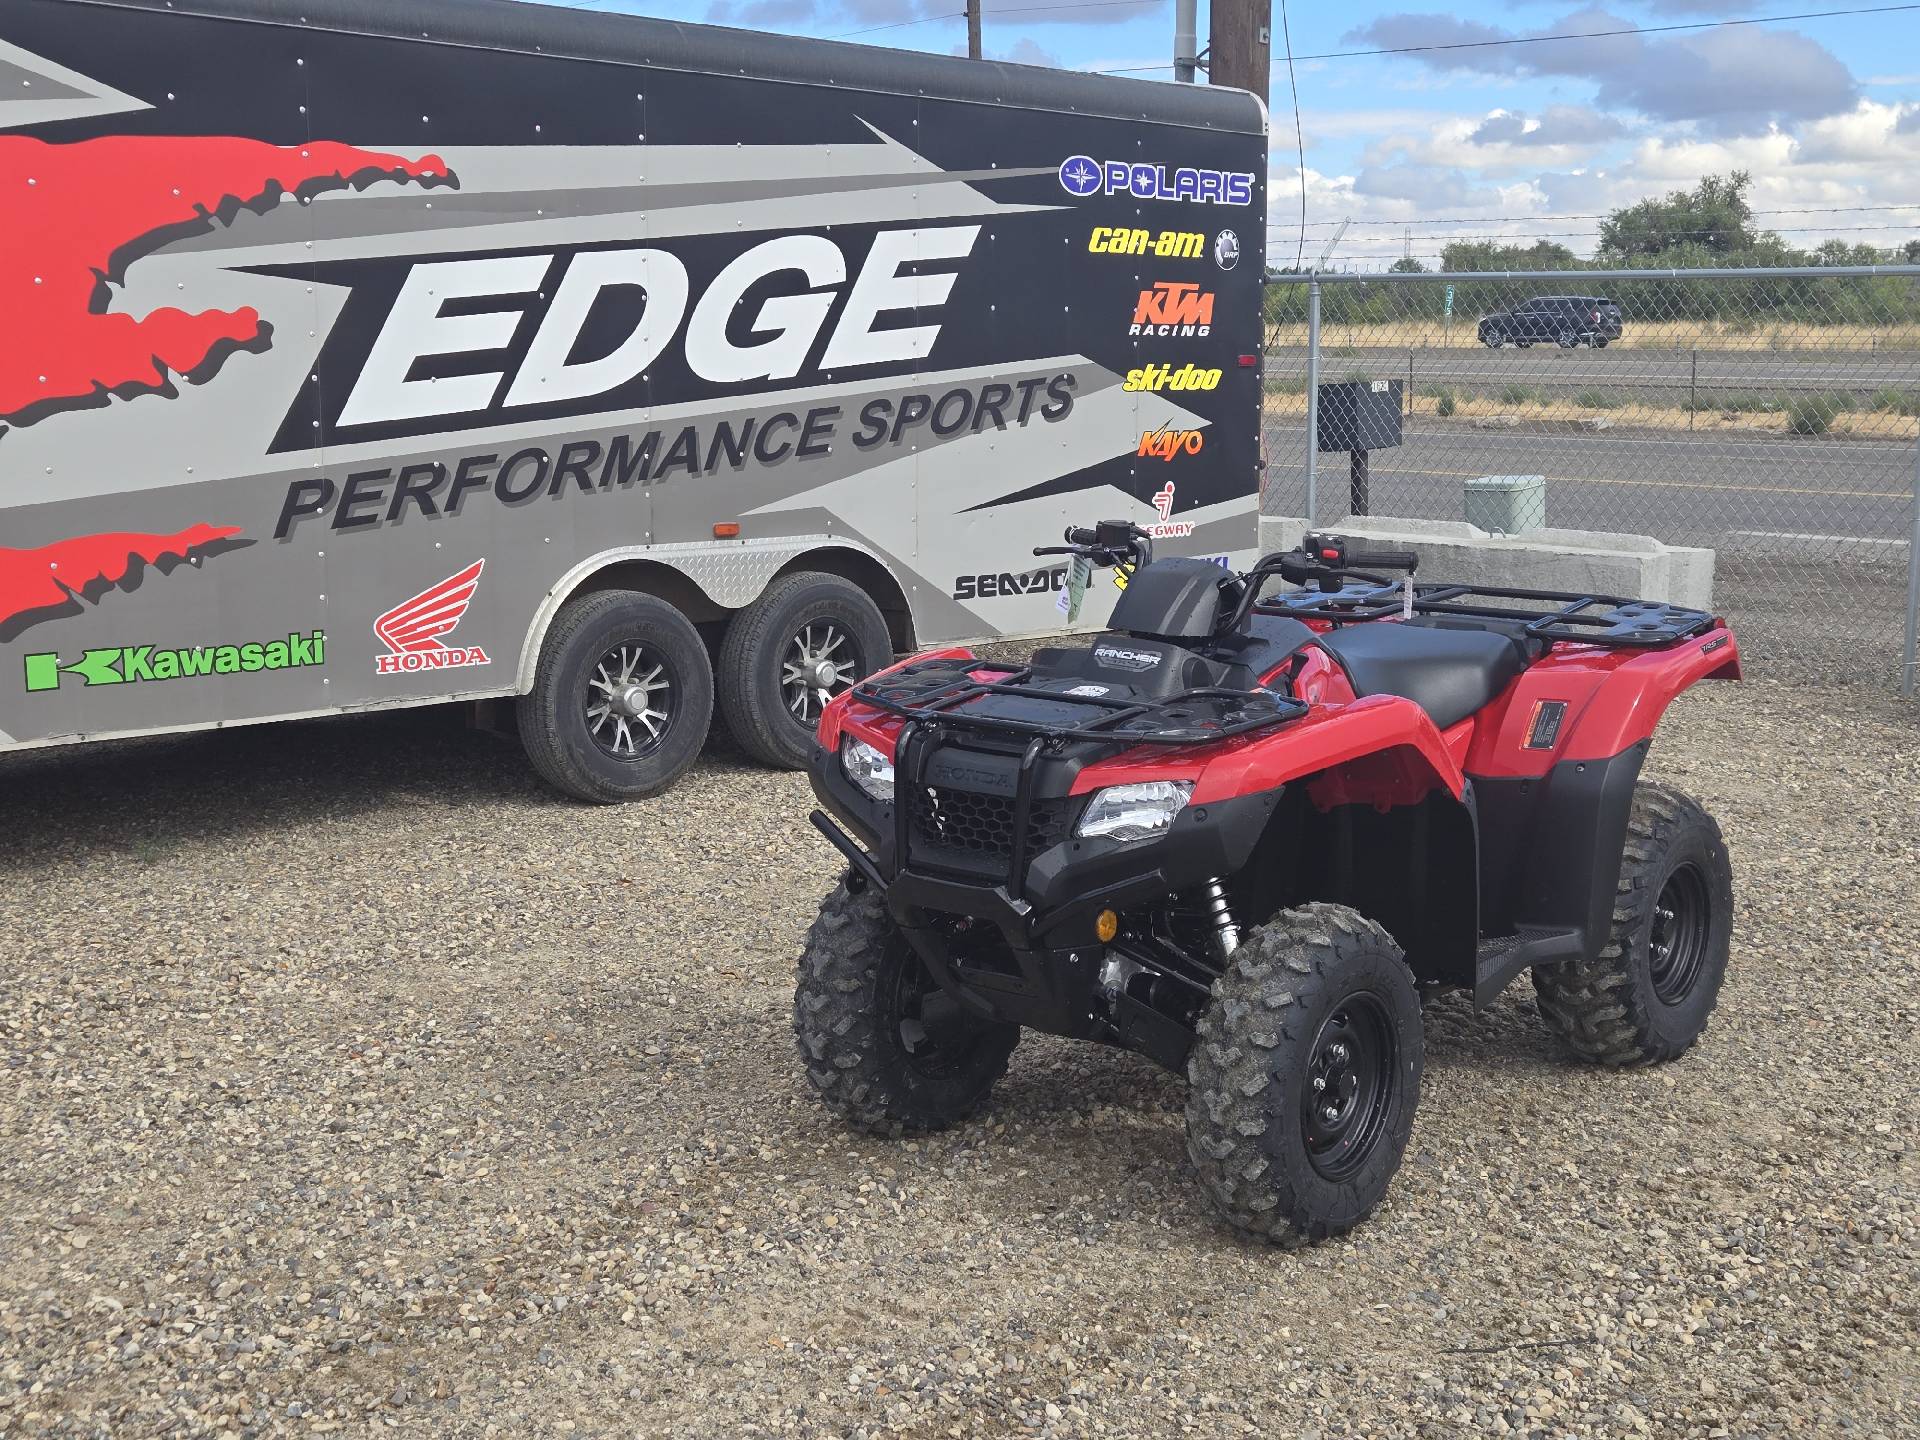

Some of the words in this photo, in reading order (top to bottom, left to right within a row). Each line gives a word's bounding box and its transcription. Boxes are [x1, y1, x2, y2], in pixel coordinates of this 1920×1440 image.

[1104, 160, 1252, 205] POLARIS
[1088, 227, 1204, 258] can-am
[1132, 282, 1214, 325] KTM
[335, 225, 983, 427] EDGE
[1129, 325, 1210, 337] RACING
[1123, 363, 1222, 391] ski-doo
[273, 404, 842, 542] PERFORMANCE
[851, 372, 1077, 447] SPORTS
[1137, 424, 1203, 462] KAYO
[1143, 522, 1194, 537] EGWAY
[124, 629, 325, 683] Kawasaki
[376, 645, 492, 675] HONDA
[1094, 648, 1162, 665] RANCHER
